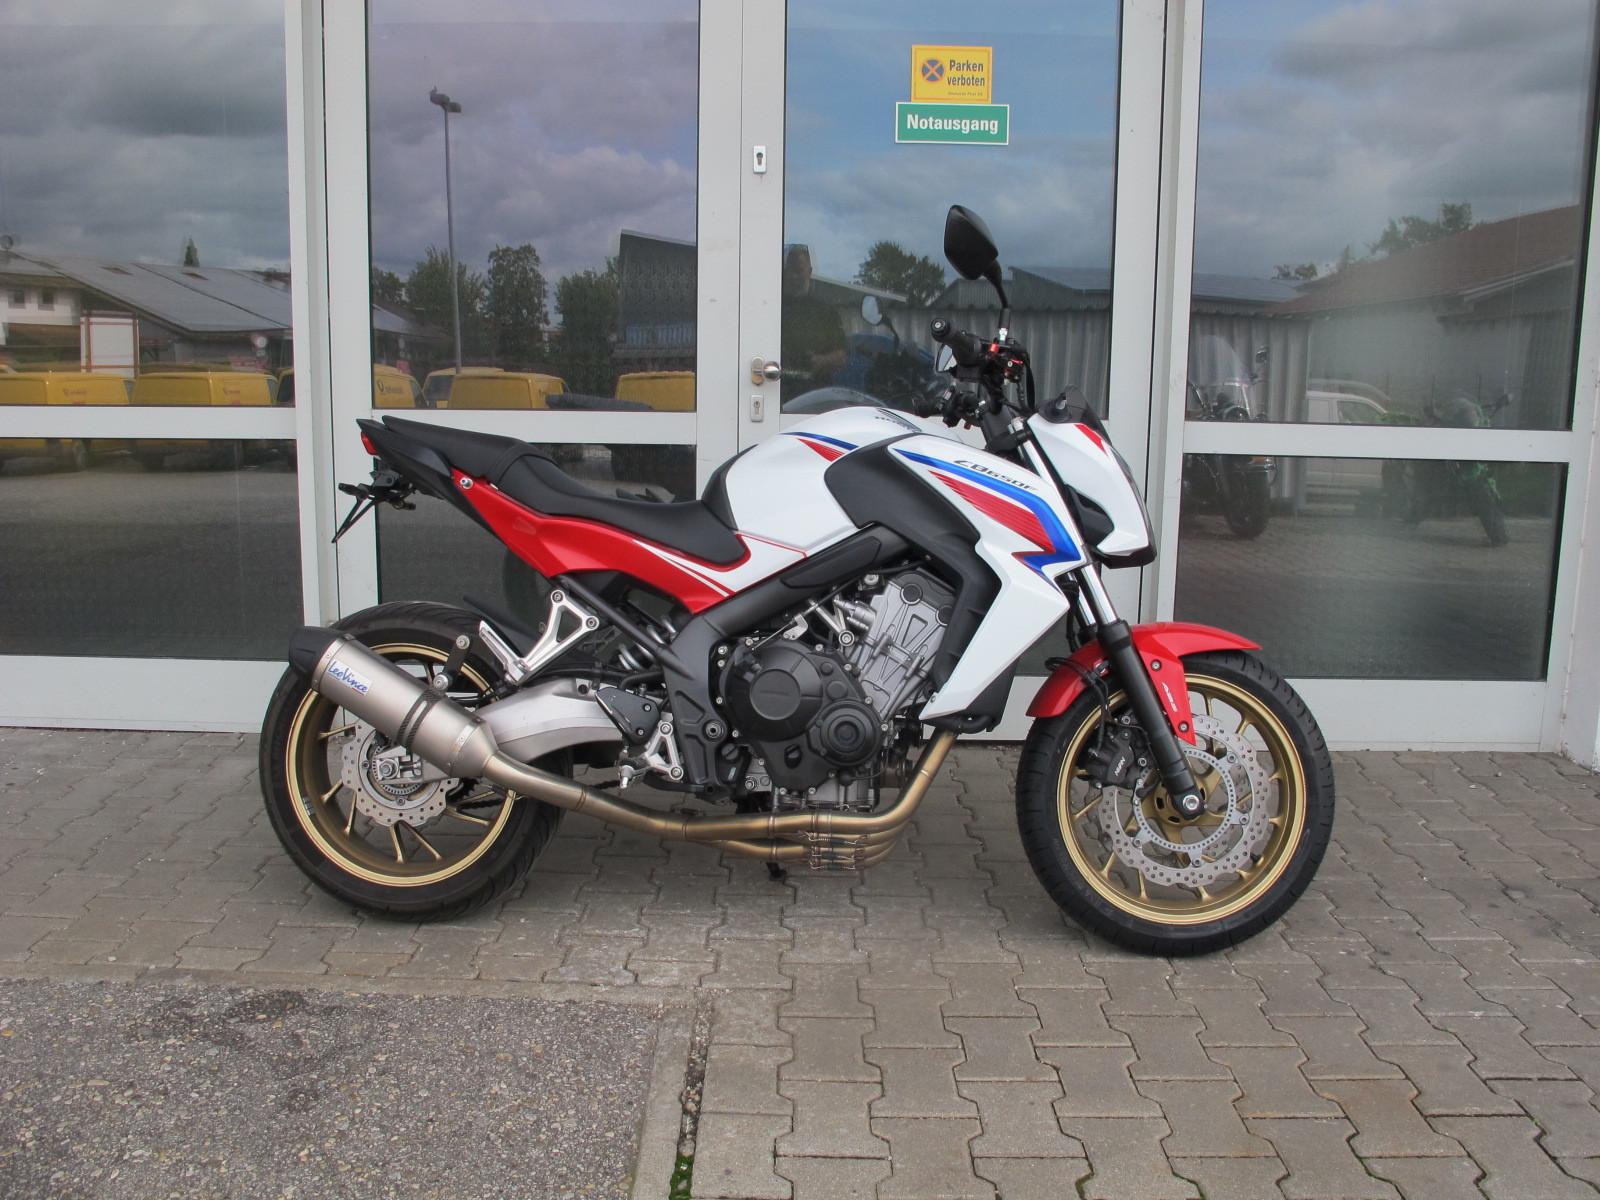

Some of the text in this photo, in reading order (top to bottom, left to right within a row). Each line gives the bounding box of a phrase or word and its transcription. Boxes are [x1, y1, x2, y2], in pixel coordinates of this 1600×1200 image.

[949, 59, 984, 72] Parken
[947, 74, 985, 87] verboten
[906, 113, 998, 135] Notausgang
[953, 460, 1038, 491] CB650F
[328, 661, 368, 693] LeoVince
